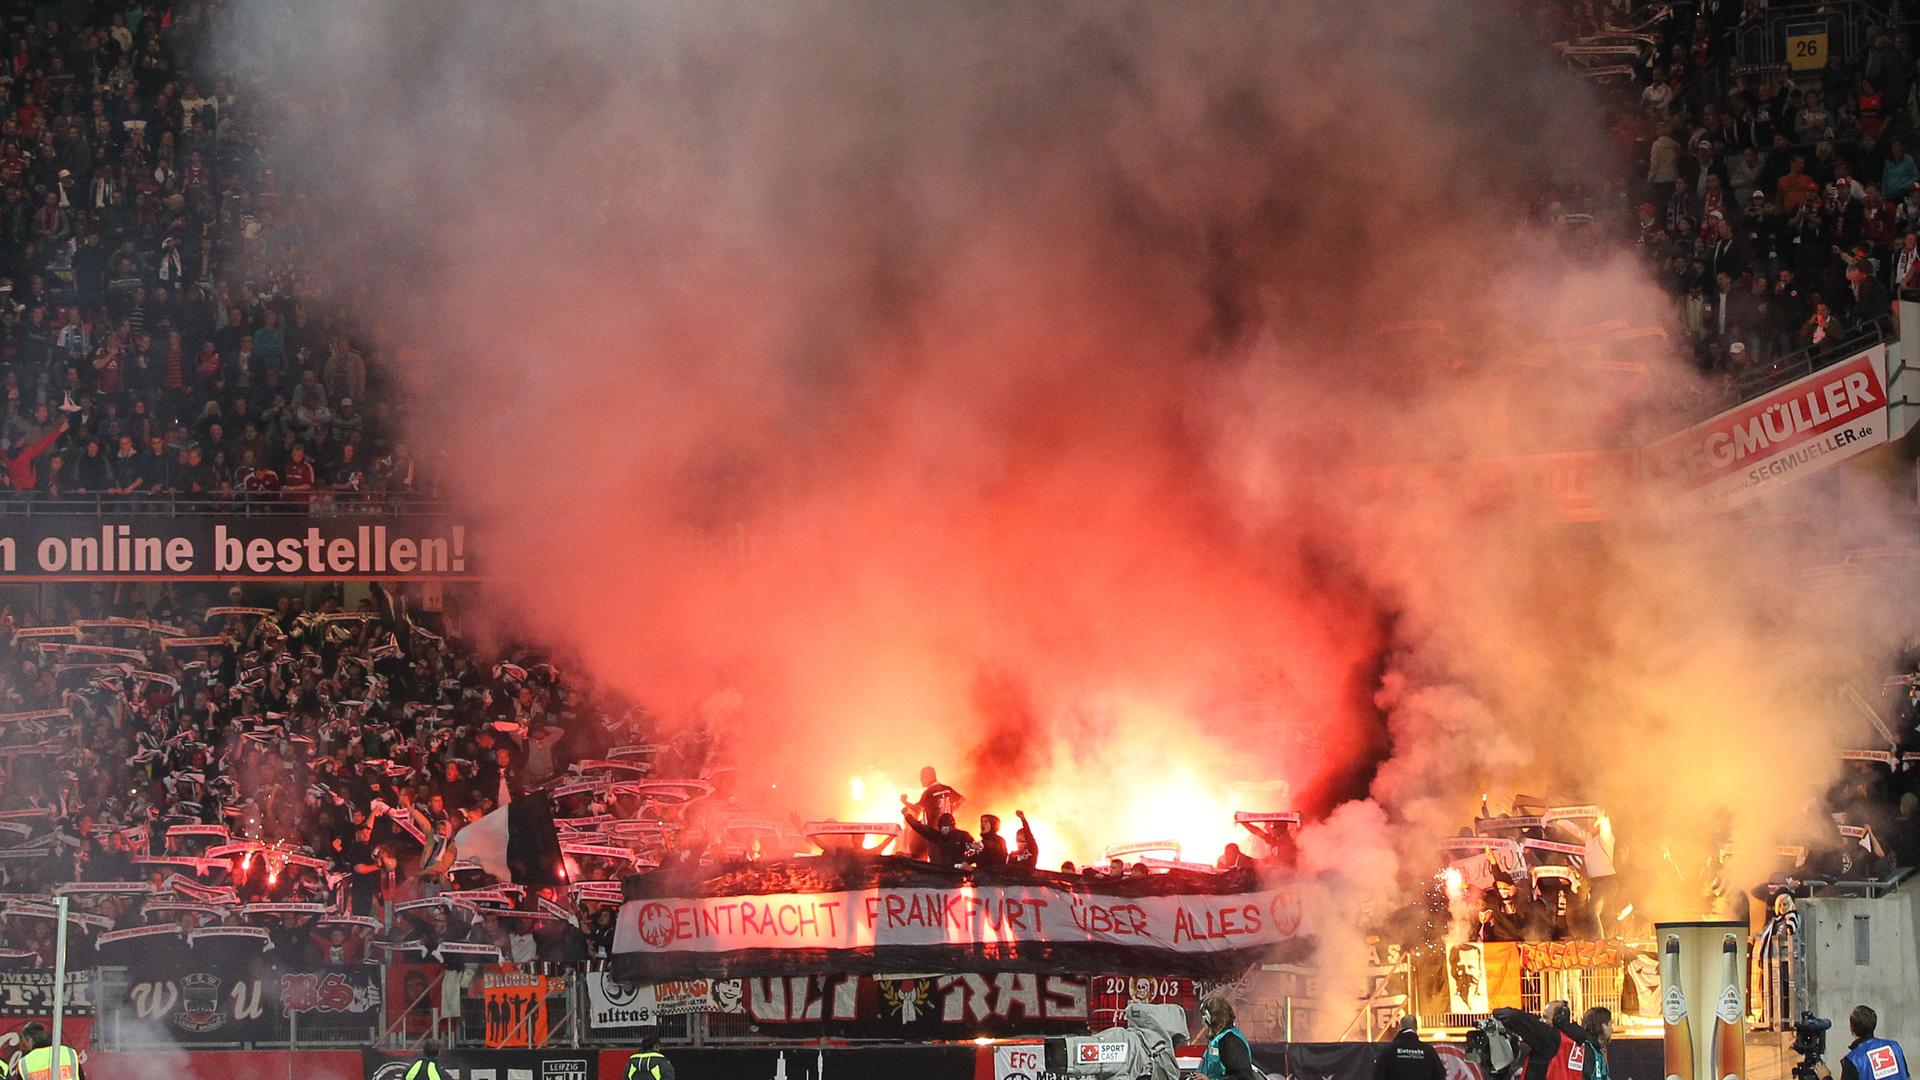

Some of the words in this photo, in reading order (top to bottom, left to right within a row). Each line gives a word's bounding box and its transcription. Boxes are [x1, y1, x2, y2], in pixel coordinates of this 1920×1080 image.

[1796, 40, 1817, 57] 26
[37, 526, 194, 572] online
[215, 525, 466, 573] bestellen!
[674, 901, 841, 940] EINTRACHT
[866, 894, 1044, 930] FRANKFURT
[1071, 902, 1148, 936] ÜBER
[1174, 903, 1262, 943] ALLES
[1106, 978, 1125, 994] 20
[1159, 982, 1179, 997] 03
[598, 1007, 649, 1024] ultras
[1101, 1044, 1126, 1053] SPORT
[1101, 1053, 1119, 1061] CAST
[550, 1063, 579, 1072] LEIPZIG
[1009, 1050, 1038, 1070] EFC
